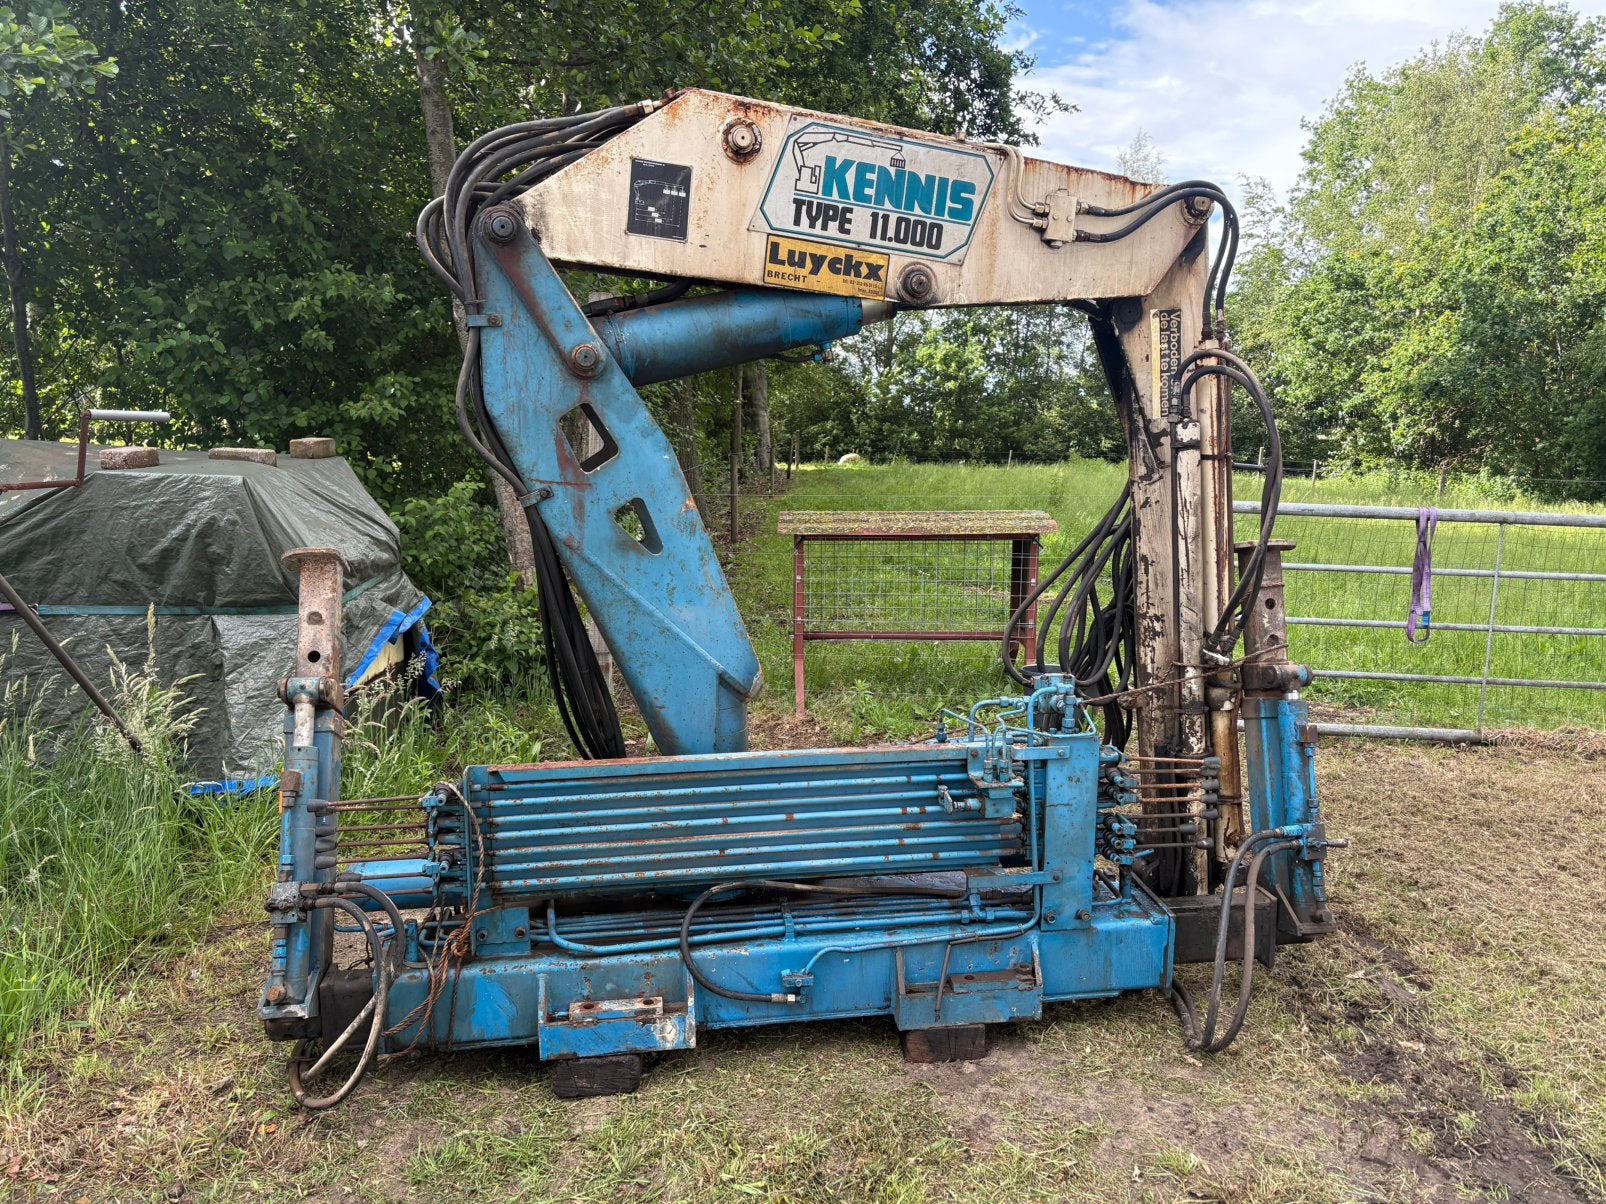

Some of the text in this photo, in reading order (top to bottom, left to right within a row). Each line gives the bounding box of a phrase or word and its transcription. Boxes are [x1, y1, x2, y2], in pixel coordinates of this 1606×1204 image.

[822, 154, 977, 222] KENNIS
[792, 198, 943, 250] TYPE 11.000
[766, 269, 807, 284] BRECHT
[767, 241, 885, 282] Luyckx
[1160, 312, 1170, 329] de
[1160, 355, 1170, 371] te
[1170, 311, 1180, 375] Verboden
[1160, 373, 1170, 416] komen
